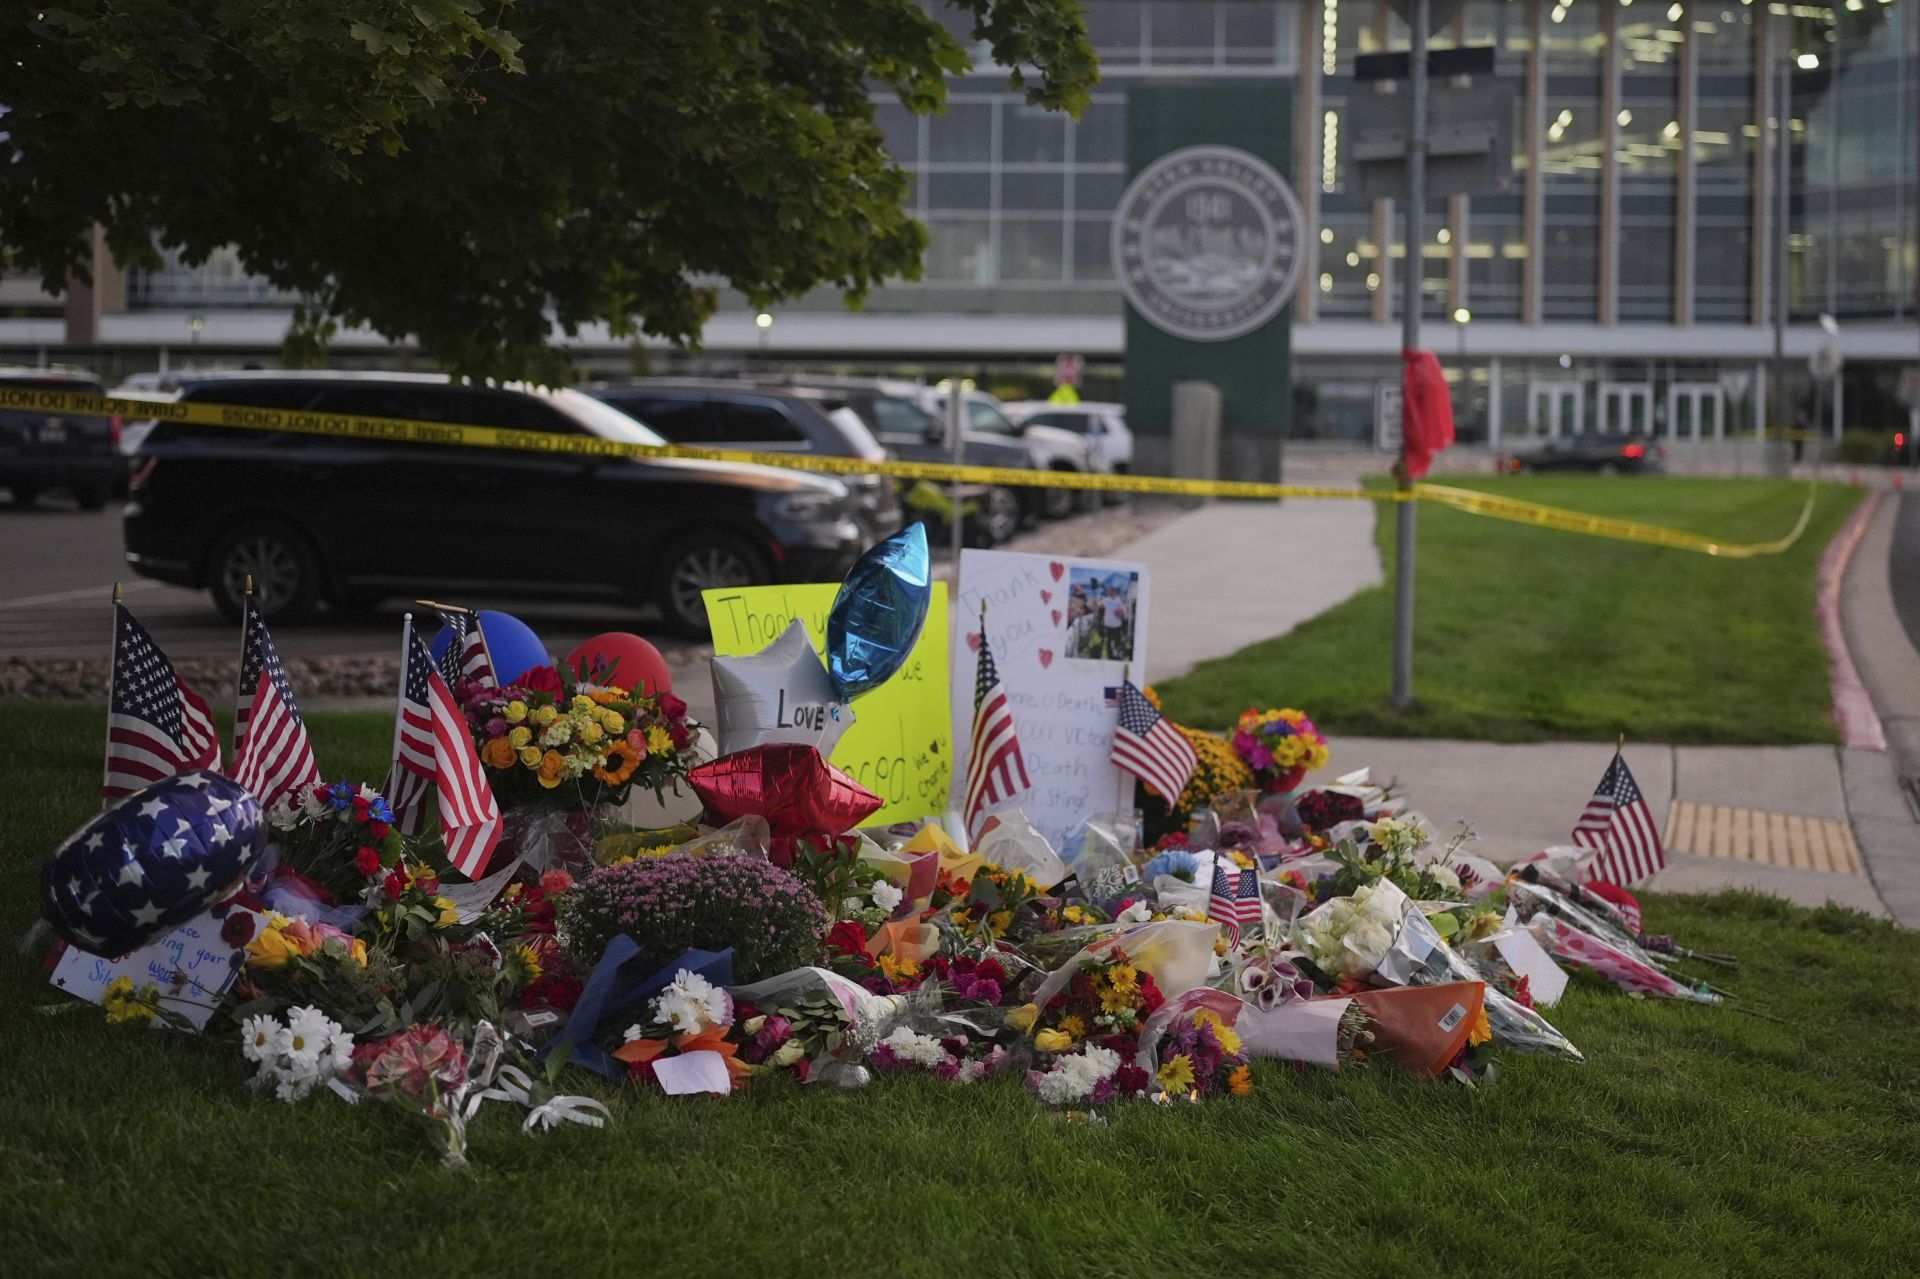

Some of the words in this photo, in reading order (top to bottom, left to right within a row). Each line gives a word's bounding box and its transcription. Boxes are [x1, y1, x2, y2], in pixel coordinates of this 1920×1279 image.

[39, 392, 66, 410] DO
[287, 411, 320, 431] NOT
[323, 416, 349, 433] DO
[991, 618, 1034, 661] you
[1028, 752, 1088, 780] Death
[188, 949, 226, 970] your
